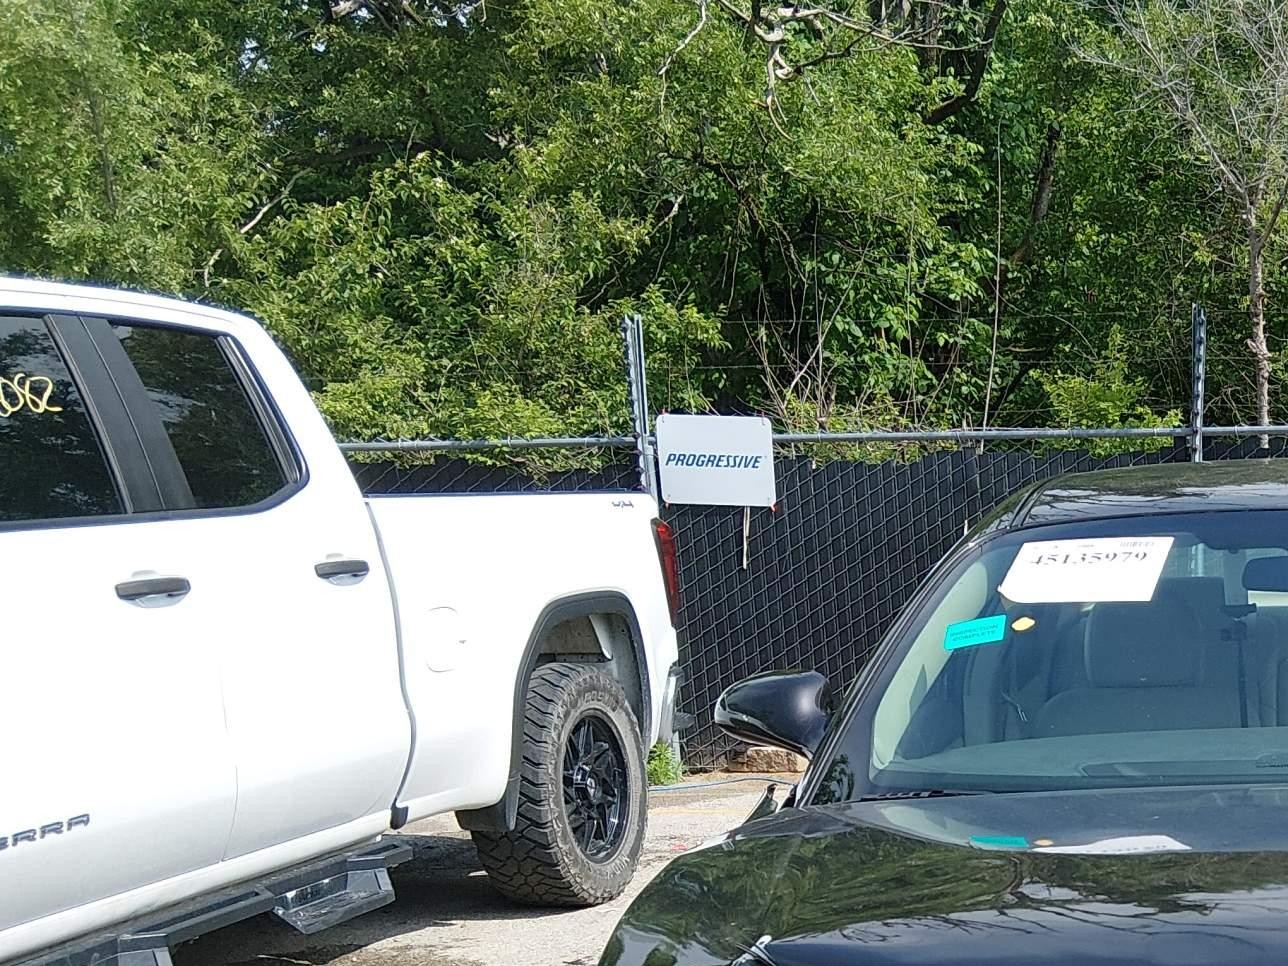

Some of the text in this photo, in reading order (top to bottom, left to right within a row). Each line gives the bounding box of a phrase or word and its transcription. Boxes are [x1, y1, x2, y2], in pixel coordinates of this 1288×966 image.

[0, 373, 63, 417] 082
[665, 453, 762, 469] PROGRESSIVE
[1029, 550, 1148, 566] 45135979
